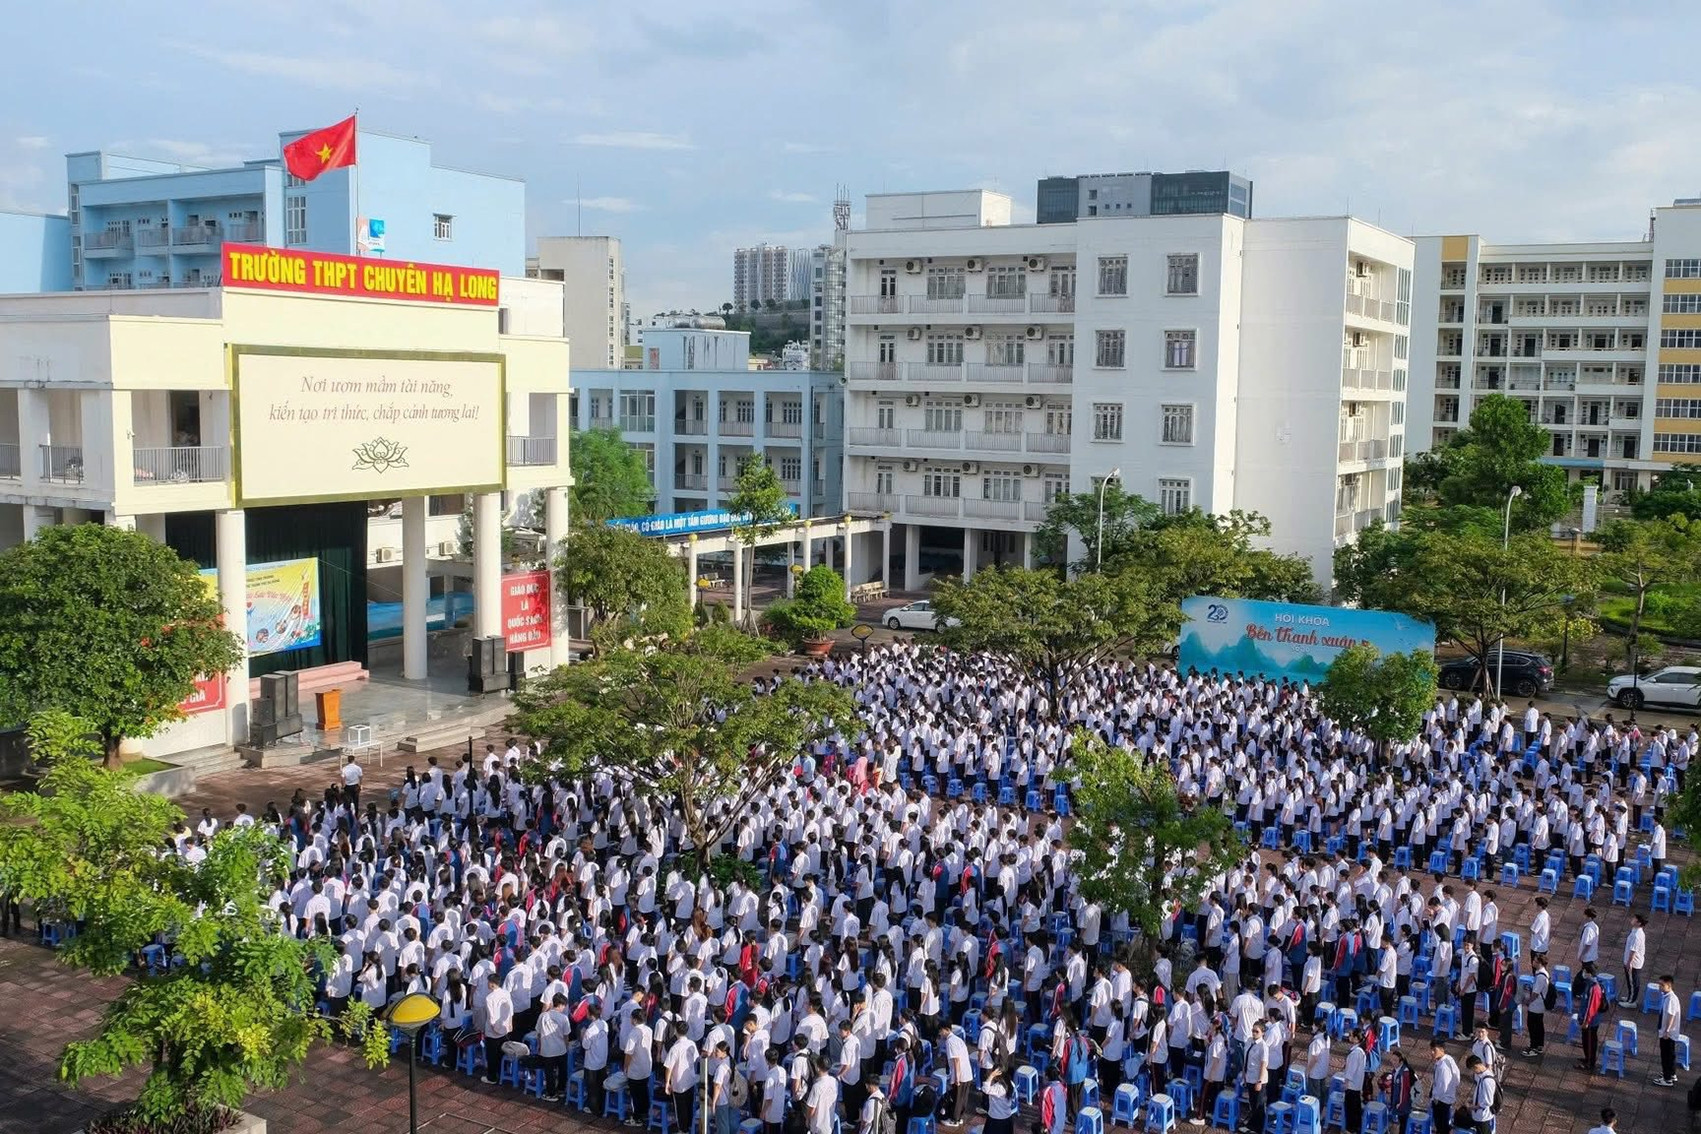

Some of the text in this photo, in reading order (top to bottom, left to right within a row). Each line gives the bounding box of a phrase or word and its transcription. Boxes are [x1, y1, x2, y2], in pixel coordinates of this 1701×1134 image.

[229, 249, 497, 302] TRƯỜNG THPT CHUYÊN HẠ LONG
[301, 376, 328, 393] Nơi
[400, 378, 417, 393] tài
[420, 380, 453, 399] năng,
[269, 400, 295, 421] kiến
[299, 408, 319, 424] tạo
[341, 404, 369, 421] thức,
[373, 401, 401, 424] chắp
[403, 403, 429, 420] cánh
[431, 407, 460, 423] tương
[461, 403, 480, 420] lai!
